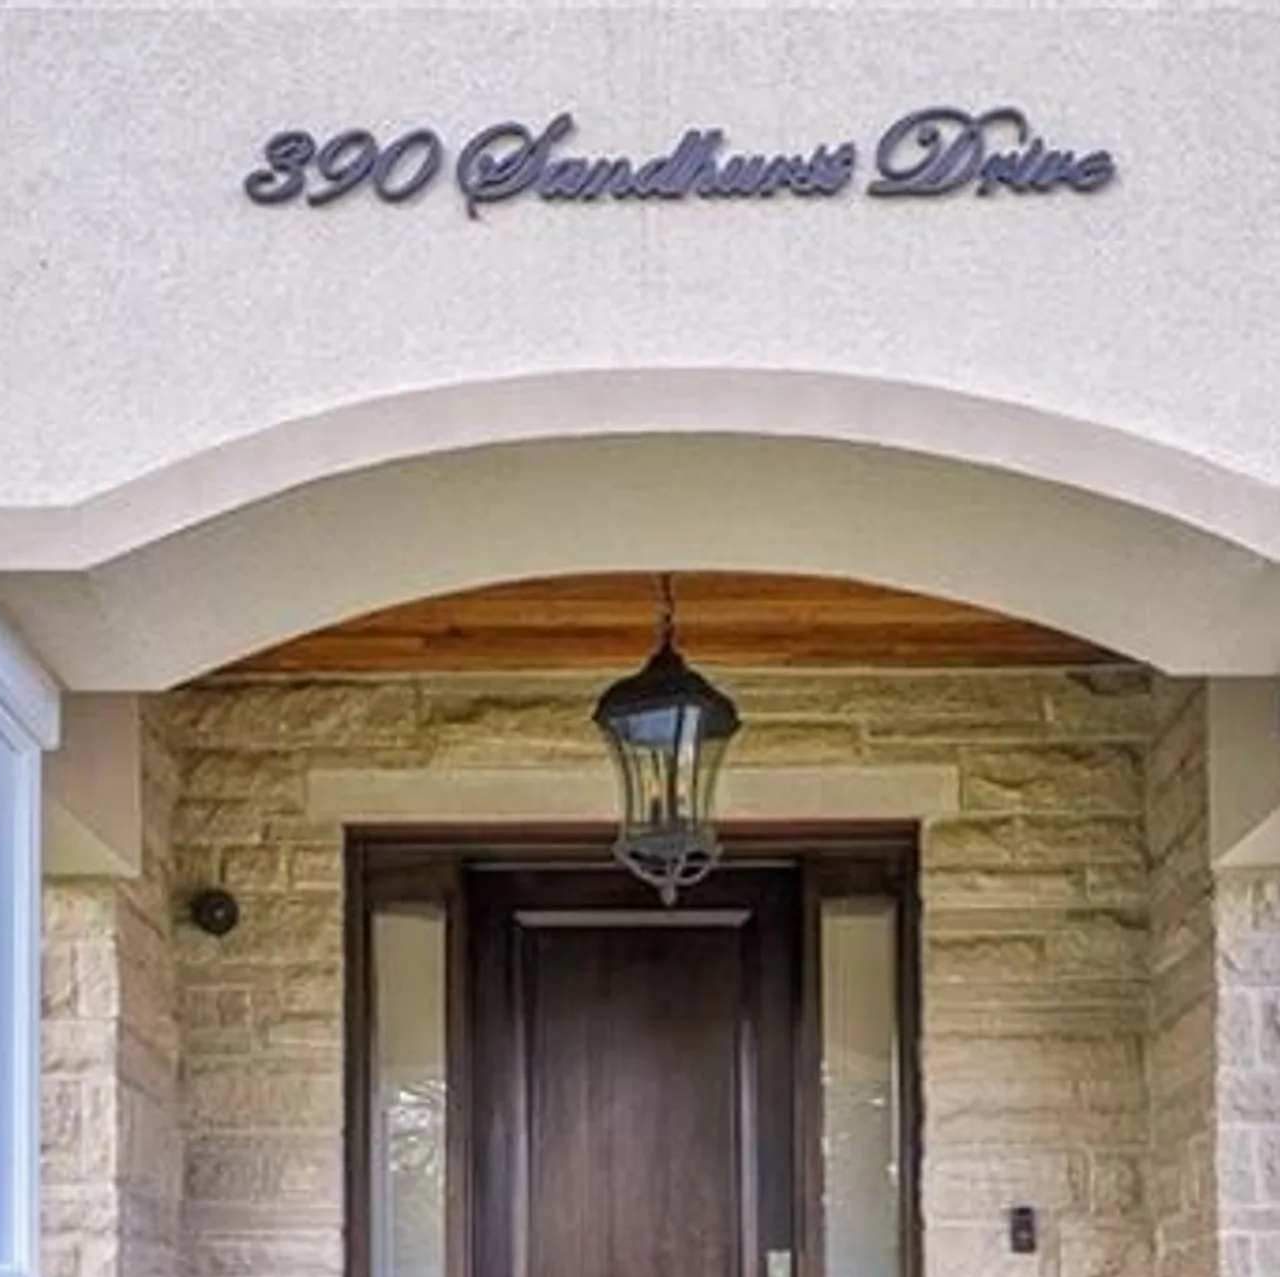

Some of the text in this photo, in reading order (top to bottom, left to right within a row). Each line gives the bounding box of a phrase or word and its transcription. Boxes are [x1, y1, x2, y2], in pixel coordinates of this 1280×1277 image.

[244, 106, 1116, 220] 390 Sandhurst Drive
